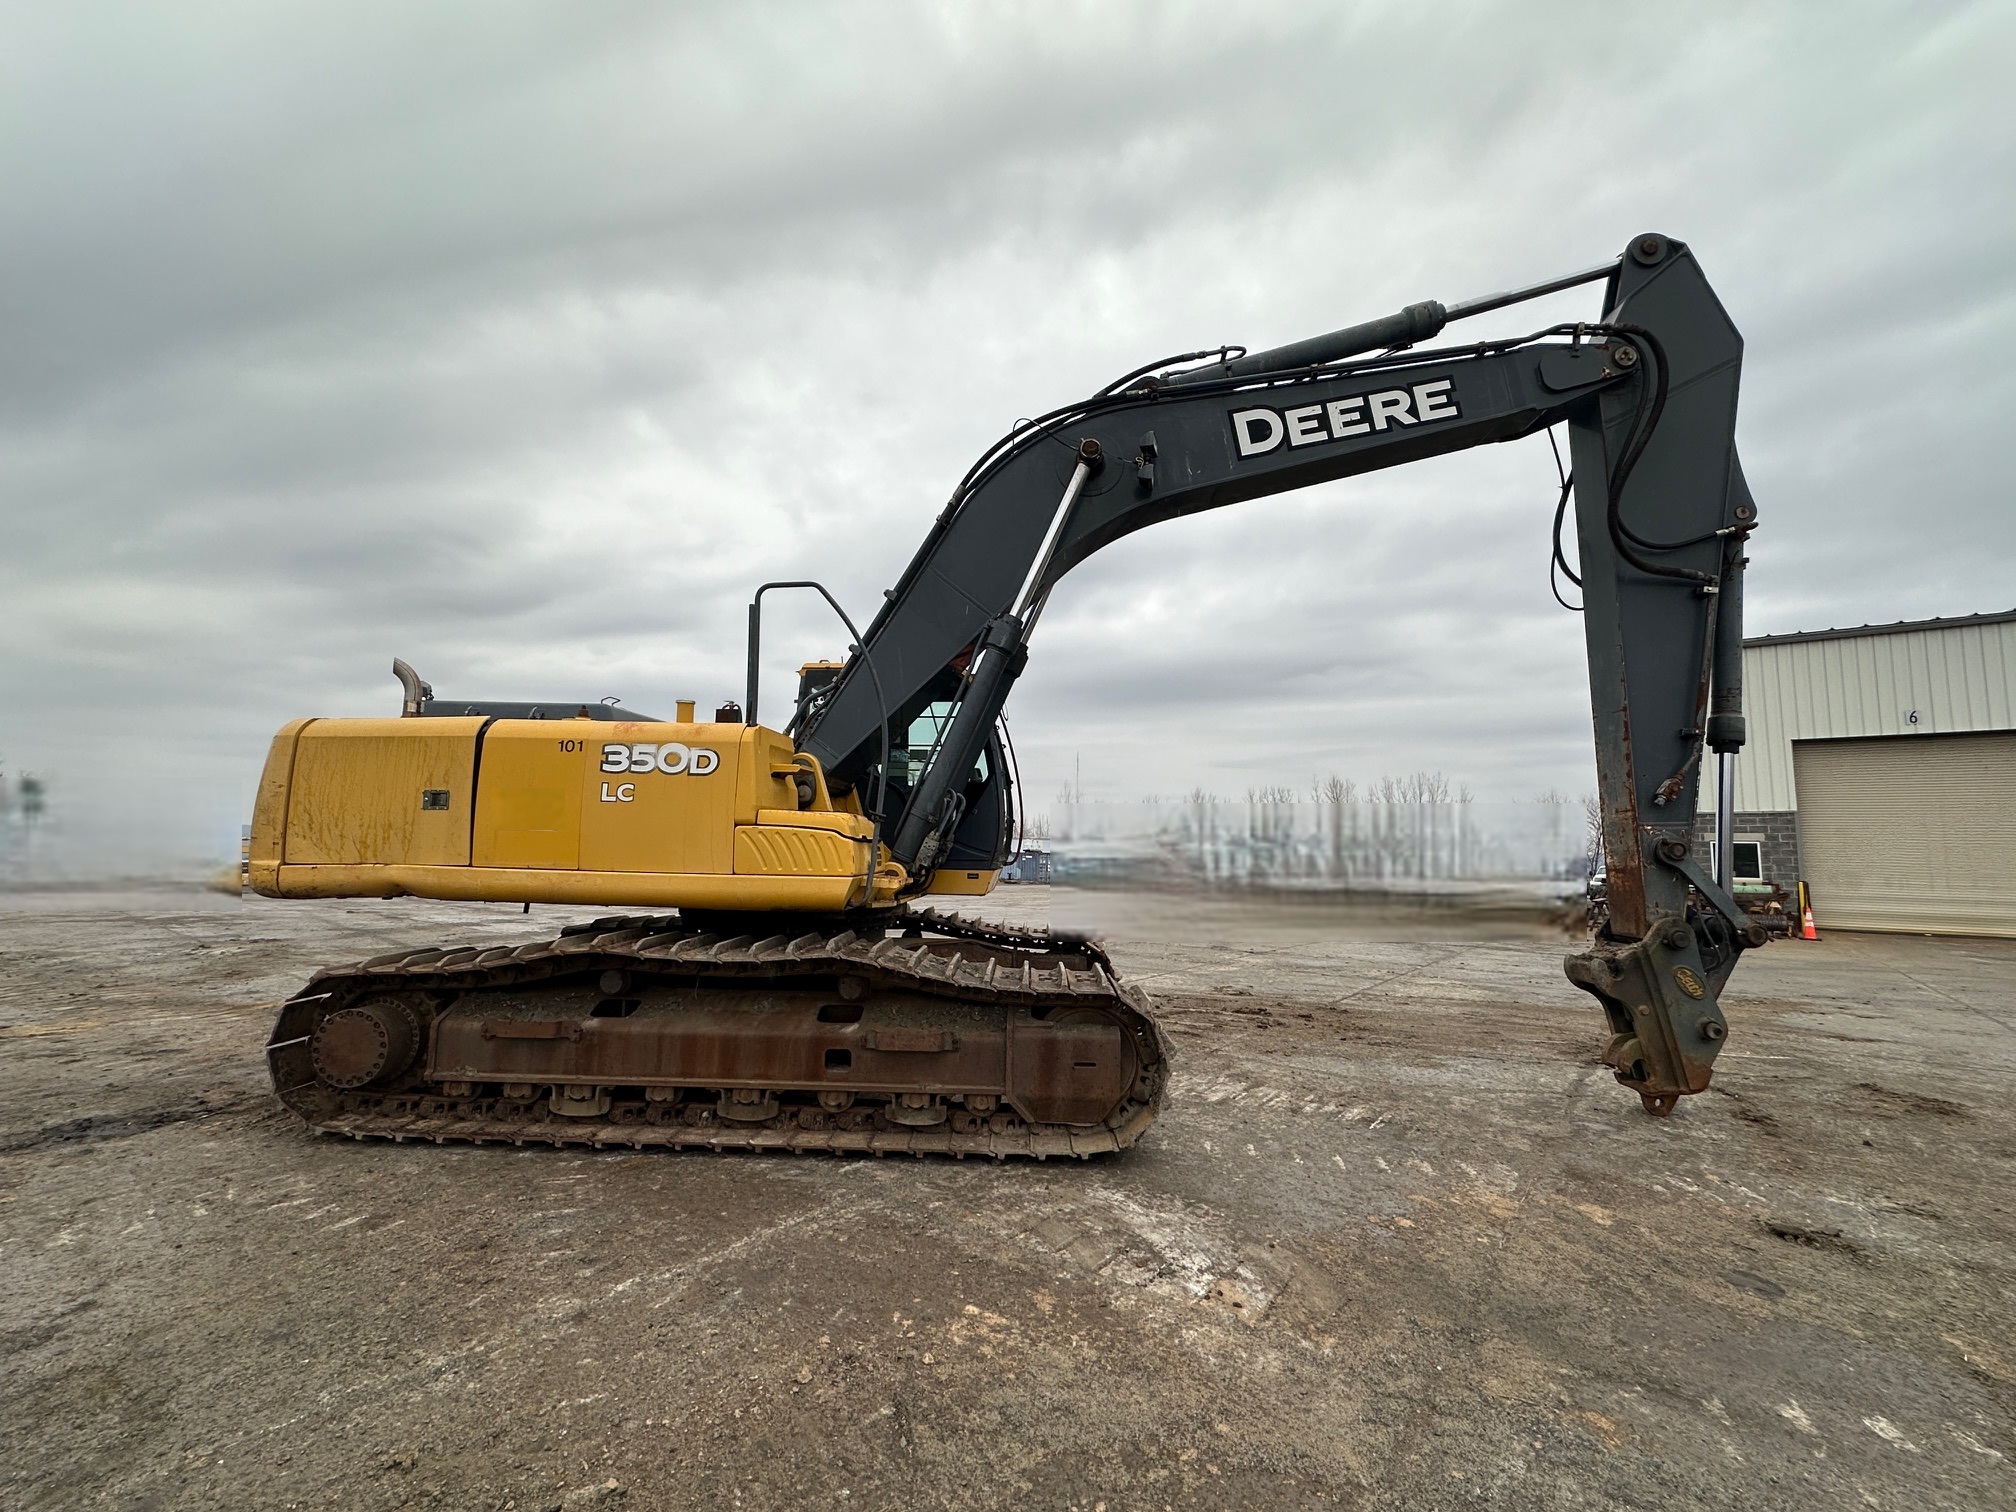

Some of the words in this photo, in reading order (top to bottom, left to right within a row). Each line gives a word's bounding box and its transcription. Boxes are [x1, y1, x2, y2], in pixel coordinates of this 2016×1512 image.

[1231, 378, 1459, 458] DEERE
[1909, 710, 1918, 724] 6
[558, 740, 584, 752] 101
[601, 743, 719, 775] 350D
[601, 782, 635, 802] LC
